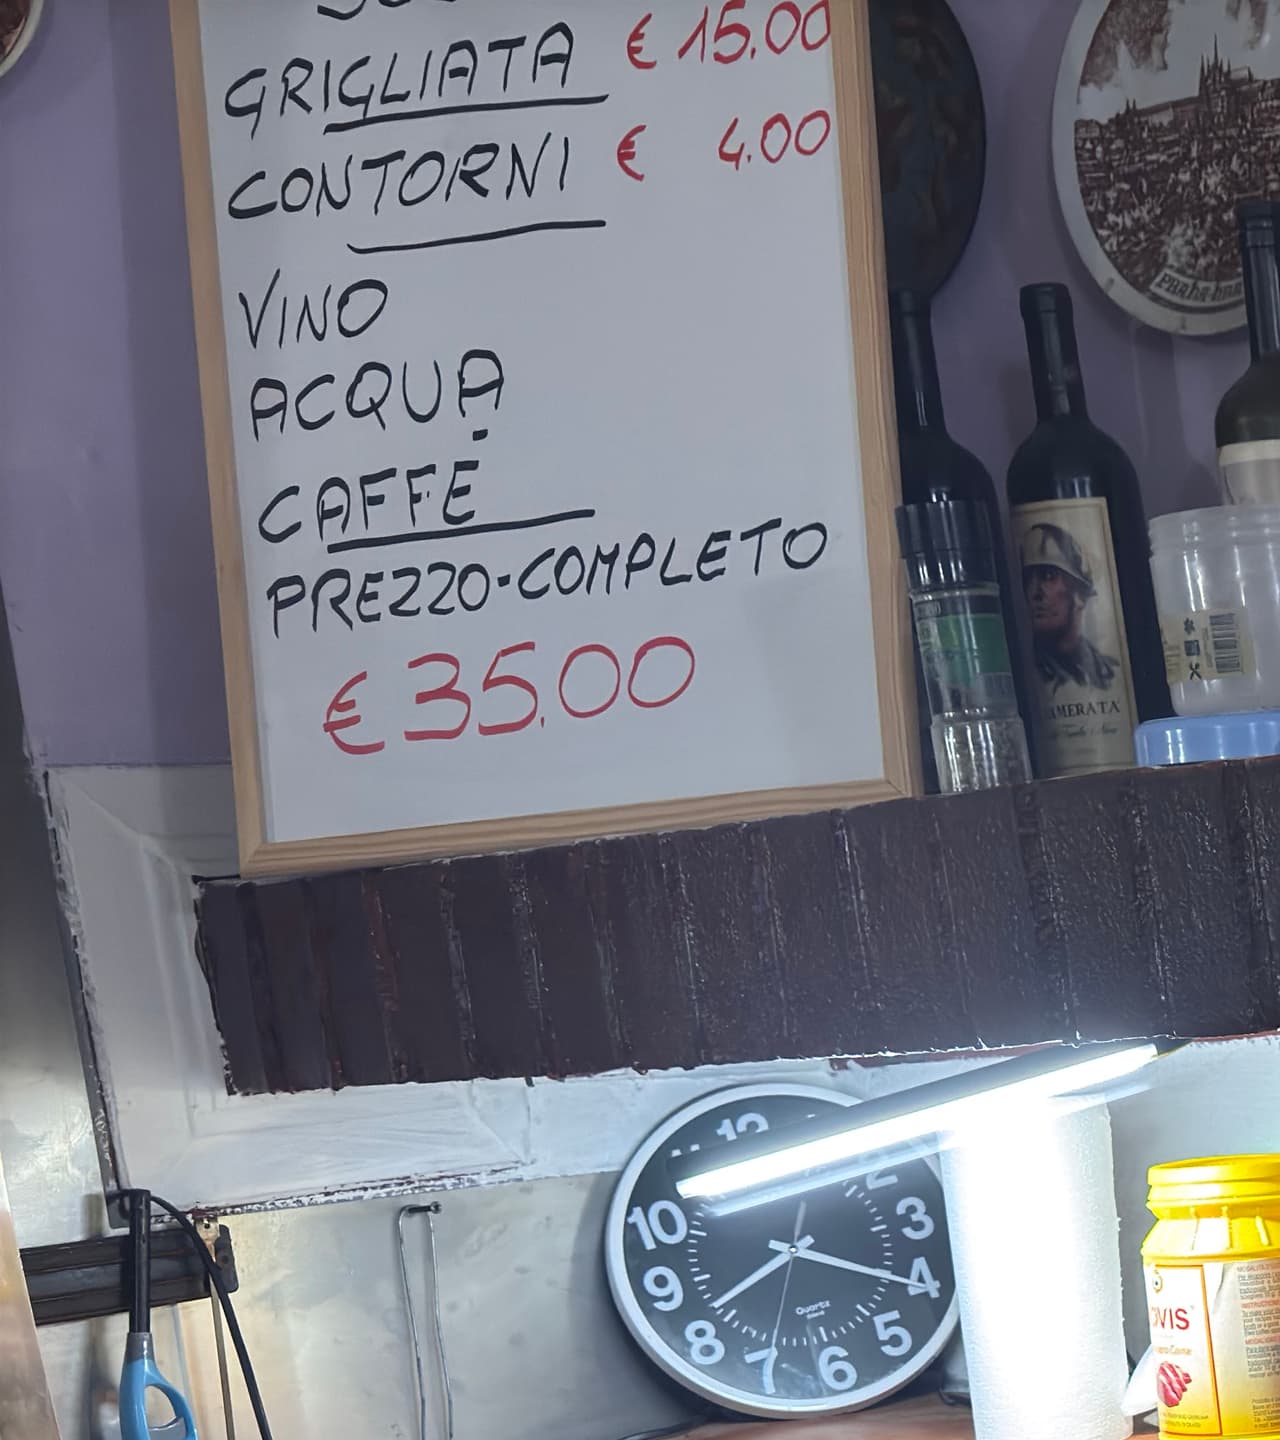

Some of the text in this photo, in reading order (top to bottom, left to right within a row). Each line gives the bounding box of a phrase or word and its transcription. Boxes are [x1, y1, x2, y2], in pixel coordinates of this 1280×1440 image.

[224, 22, 575, 138] GRIGLIATA
[626, 13, 657, 69] €
[227, 132, 571, 219] CONTORNI
[616, 125, 647, 182] €
[238, 269, 388, 349] VINO
[250, 350, 505, 442] ACQUA
[626, 1200, 688, 1251] 10
[896, 1197, 935, 1240] 3
[642, 1266, 684, 1312] 9
[907, 1256, 941, 1299] 4
[684, 1319, 726, 1366] 8
[872, 1310, 913, 1356] 5
[744, 1347, 779, 1394] 7
[818, 1345, 858, 1391] 6
